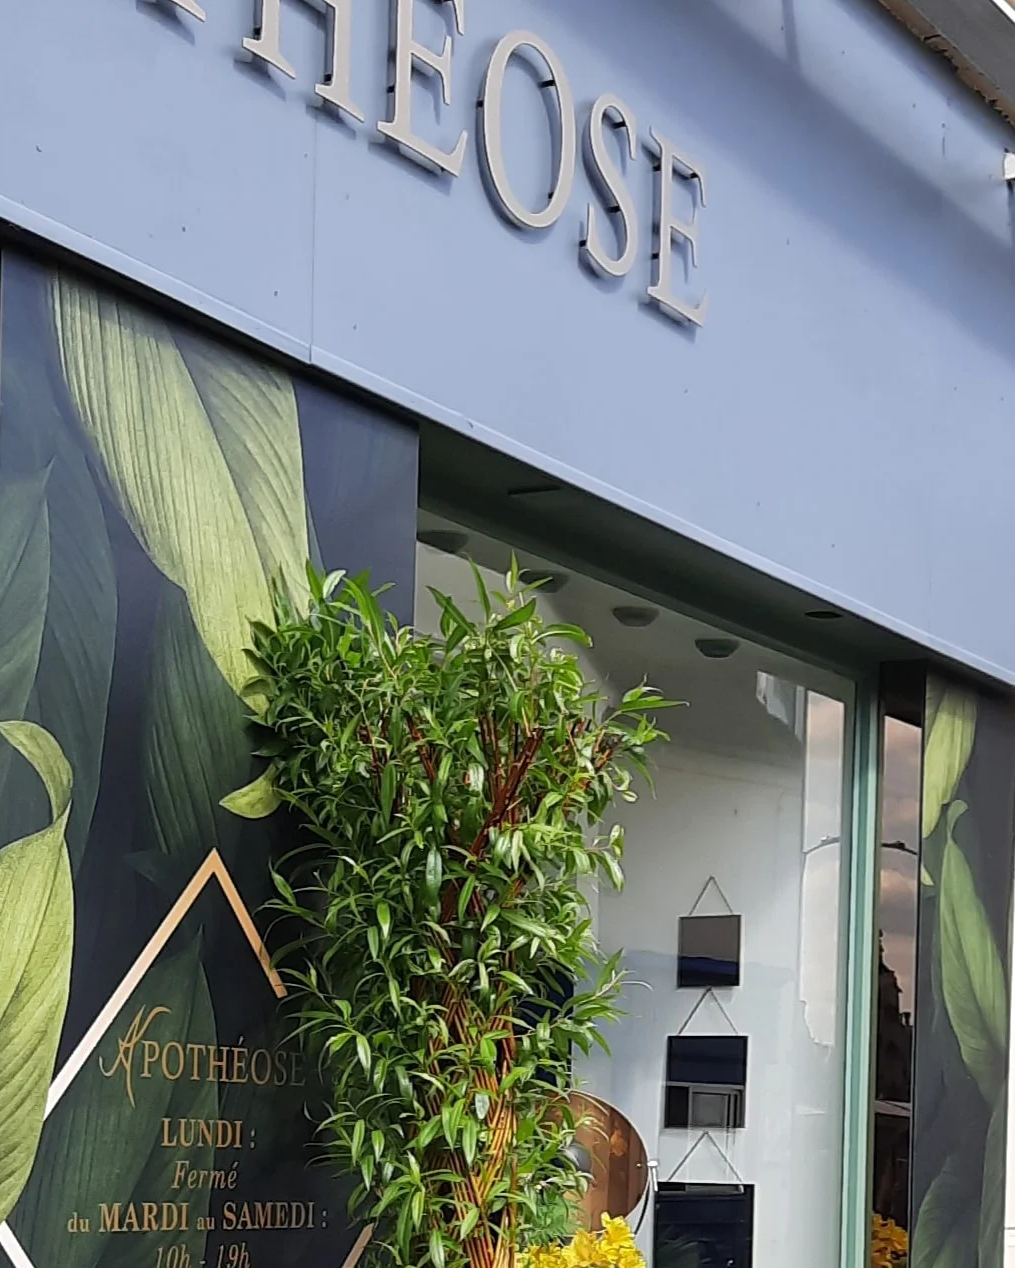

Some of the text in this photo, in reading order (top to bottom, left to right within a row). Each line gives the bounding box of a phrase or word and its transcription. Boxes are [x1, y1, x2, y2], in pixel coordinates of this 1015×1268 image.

[170, 0, 708, 327] HEOSE
[161, 1118, 243, 1149] LUNDI
[171, 1160, 237, 1189] Fermé
[67, 1212, 90, 1233] du
[98, 1202, 189, 1233] MARDI
[196, 1216, 215, 1231] au
[222, 1202, 315, 1231] SAMEDI
